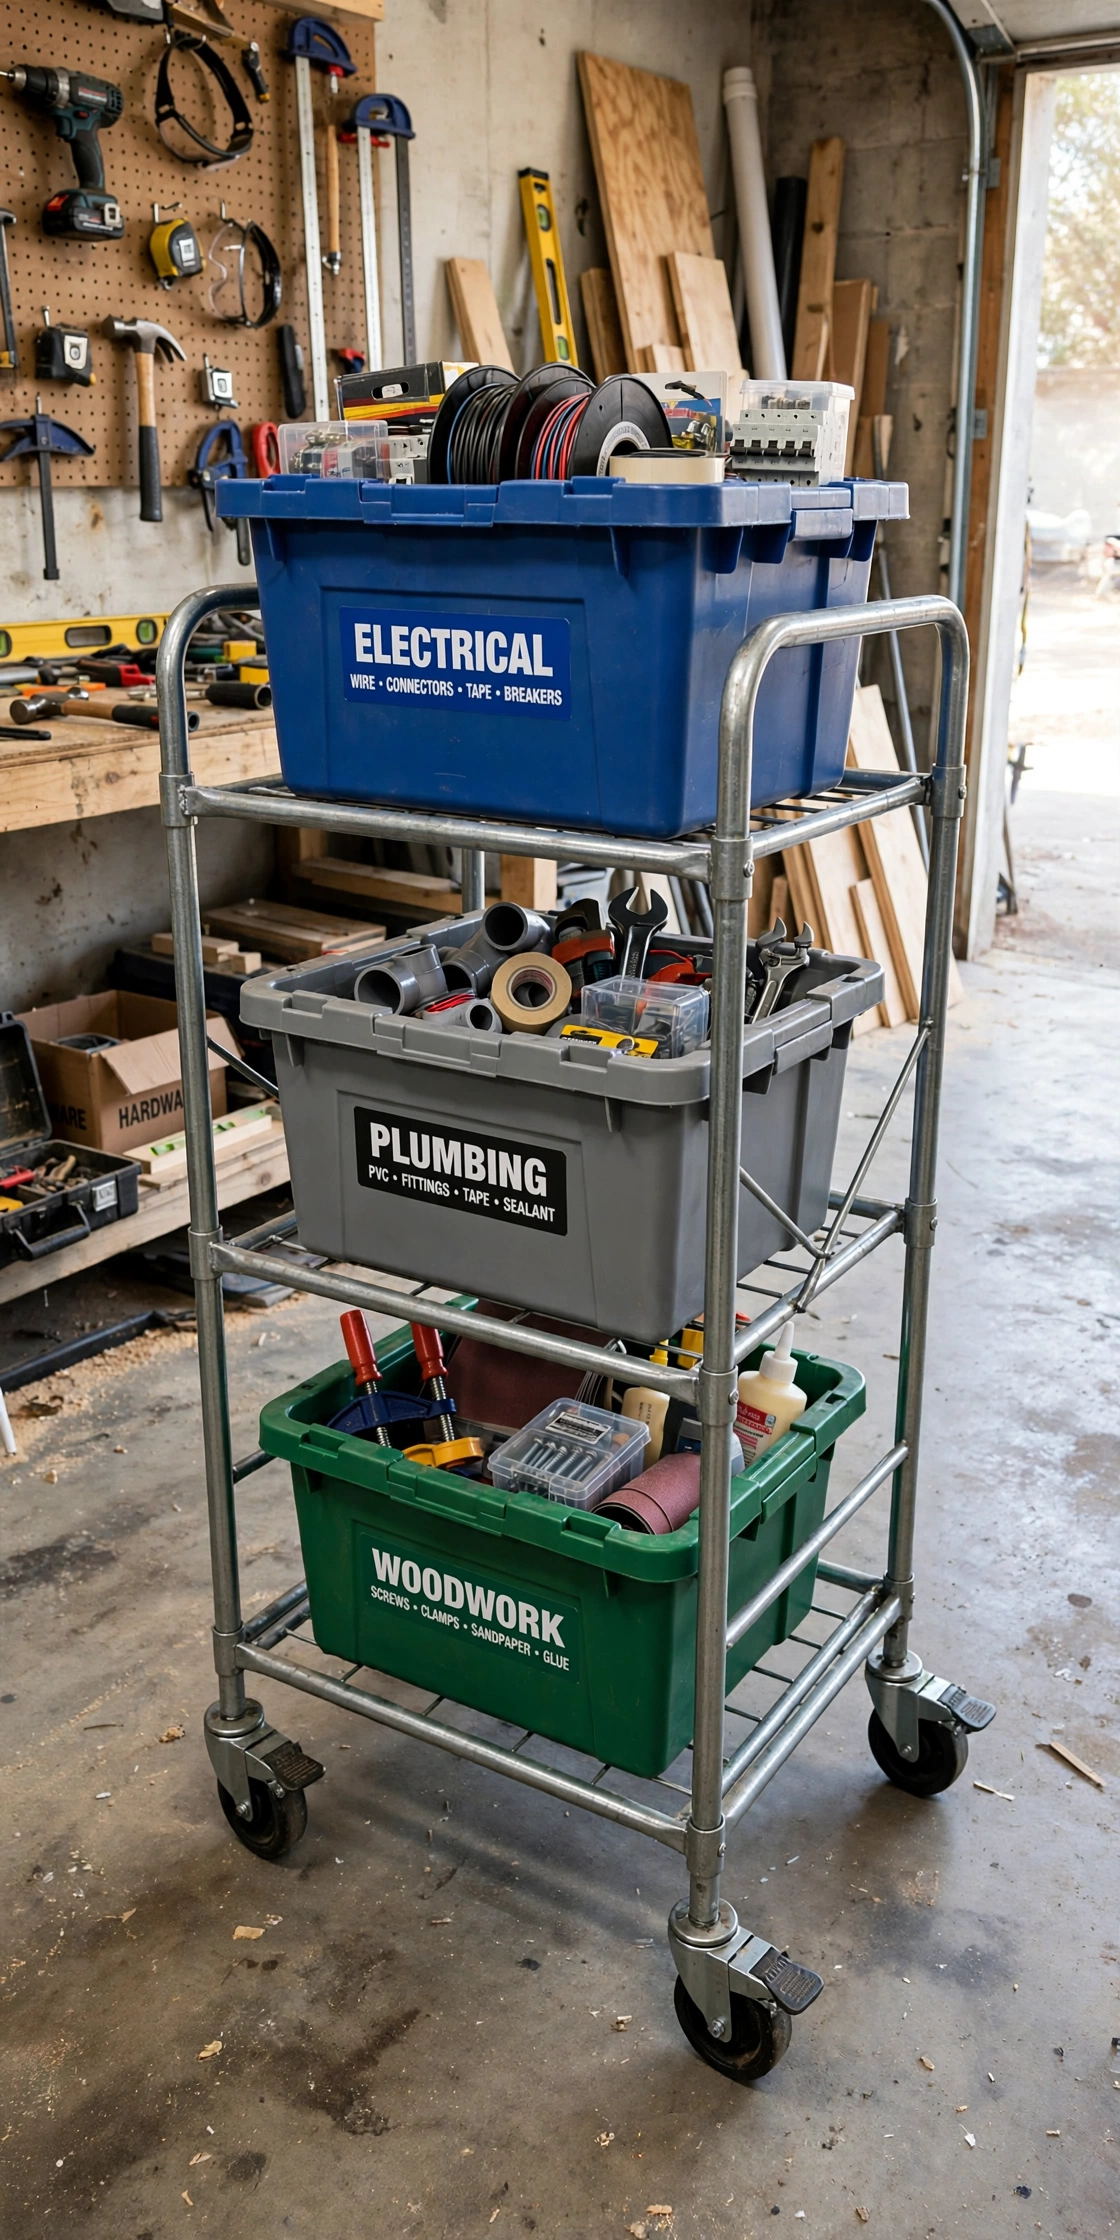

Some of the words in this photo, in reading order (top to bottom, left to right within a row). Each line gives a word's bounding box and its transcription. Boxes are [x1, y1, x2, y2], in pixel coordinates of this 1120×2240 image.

[354, 623, 553, 677] ELECTRICAL
[350, 673, 376, 691] WIRE
[386, 676, 454, 697] CONNECTORS
[466, 682, 492, 700] TAPE
[504, 685, 562, 706] BREAKERS
[119, 1089, 184, 1129] HARDWA
[370, 1121, 547, 1197] PLUMBING
[368, 1164, 389, 1183] PVC
[401, 1173, 450, 1197] FITTINGS
[462, 1187, 490, 1207] TAPE
[503, 1196, 555, 1222] SEALANT
[371, 1547, 566, 1649] WOODWORK
[370, 1585, 411, 1611] SCREWS
[421, 1604, 460, 1630] CLAMPS
[471, 1622, 531, 1657] SANDPAPER
[543, 1650, 570, 1671] GLUE
